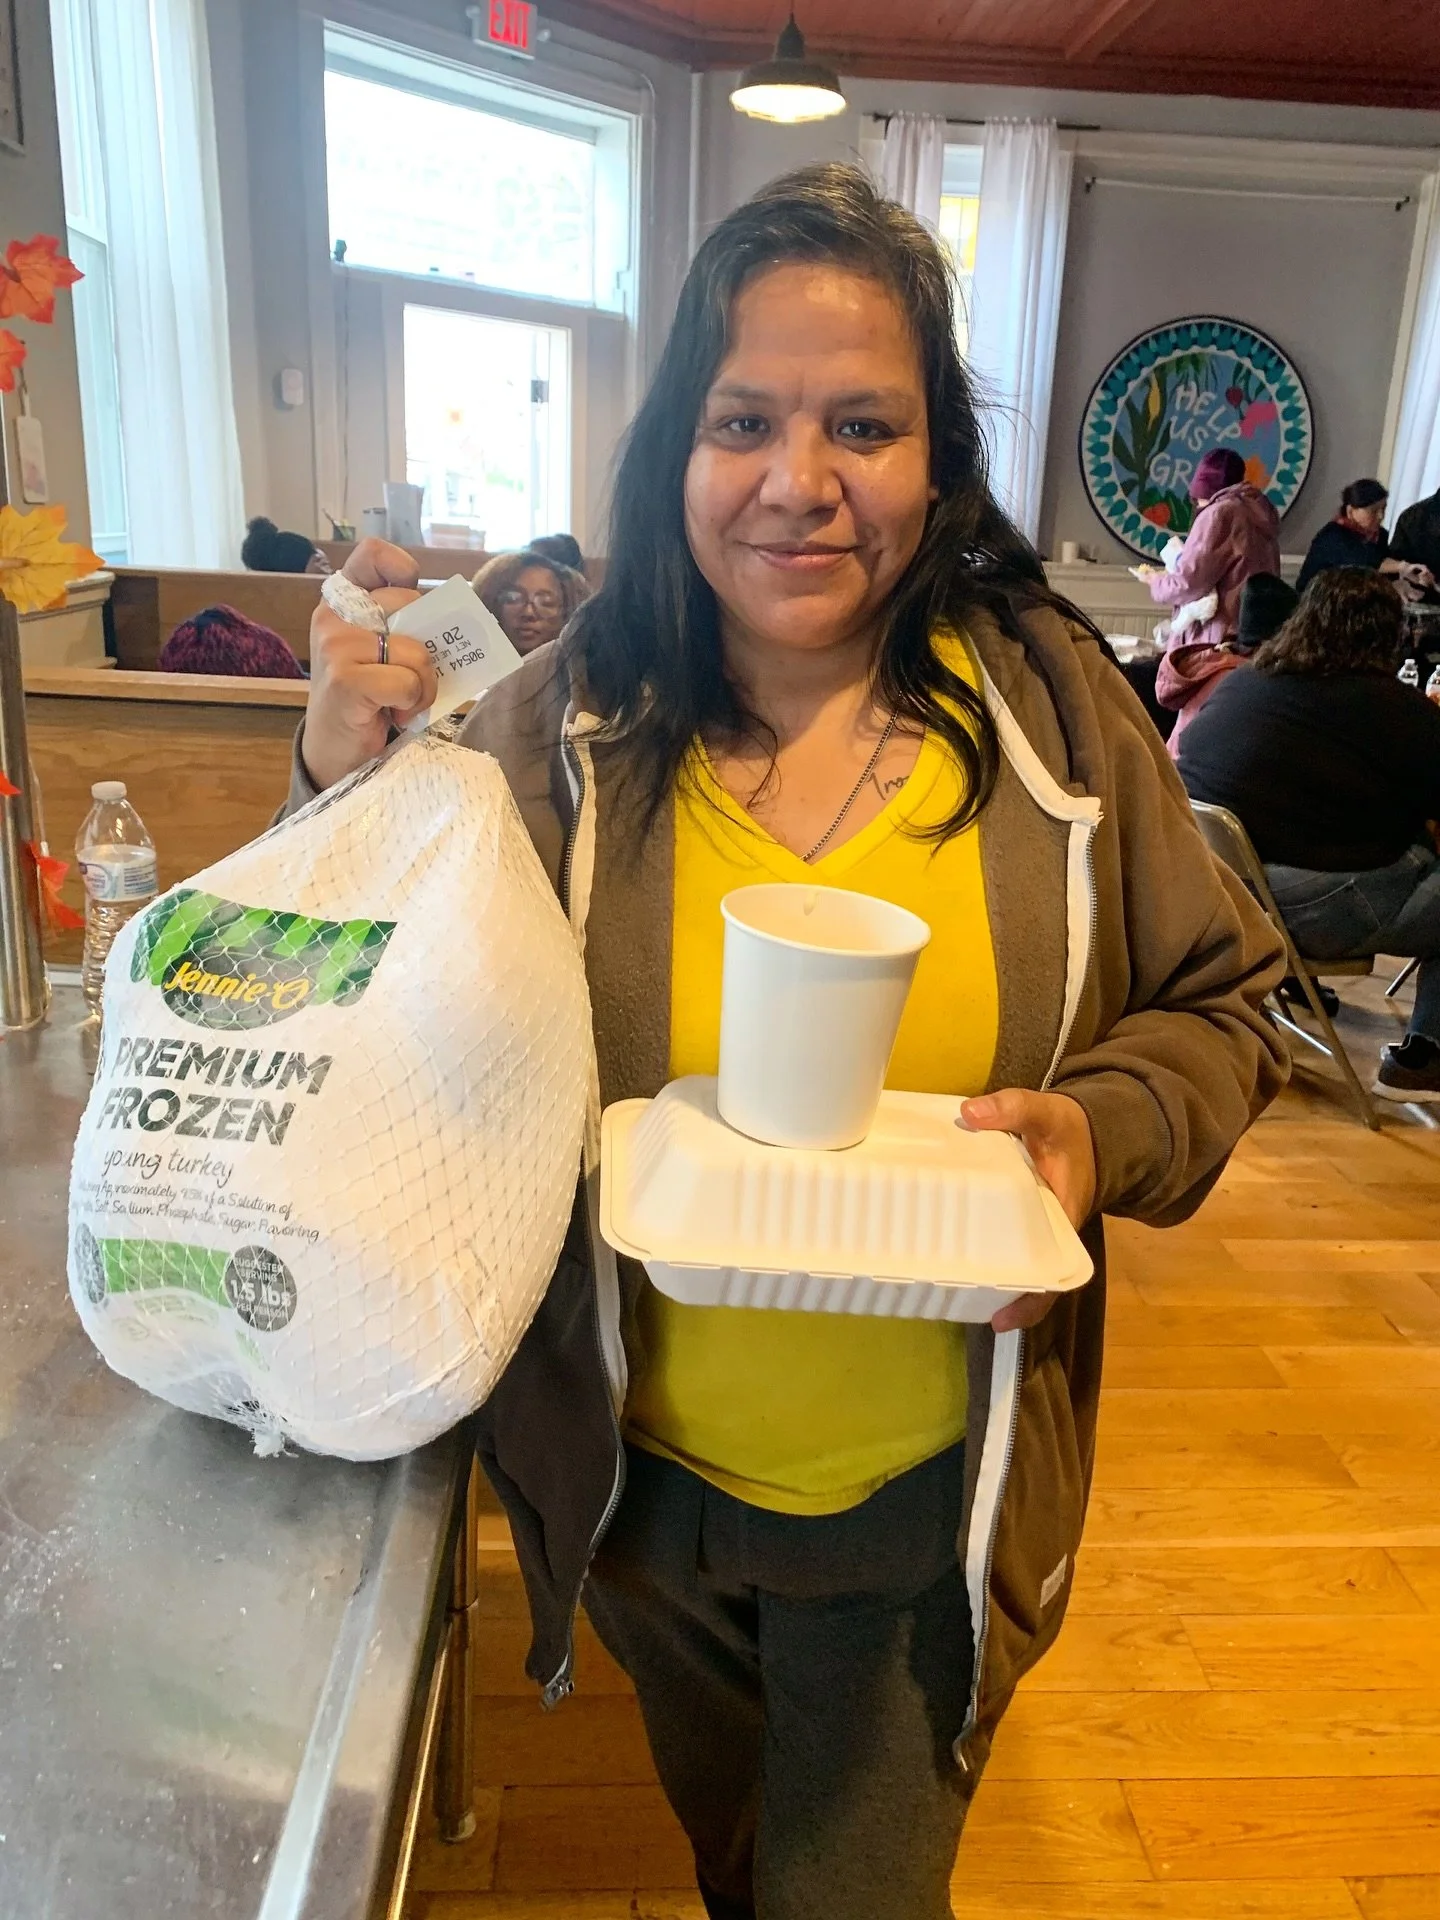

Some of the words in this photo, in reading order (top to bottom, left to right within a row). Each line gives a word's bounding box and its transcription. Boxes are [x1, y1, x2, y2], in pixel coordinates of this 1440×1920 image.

[489, 0, 531, 49] EXIT
[1174, 380, 1242, 442] HELP
[1169, 416, 1210, 452] US
[1149, 451, 1193, 489] GR
[449, 648, 485, 671] 90544
[455, 639, 472, 652] NET
[164, 961, 310, 1010] Jennie-O
[110, 1036, 333, 1096] PREMIUM
[96, 1086, 297, 1146] FROZEN
[101, 1149, 162, 1180] young
[168, 1148, 234, 1189] turkey
[279, 1202, 294, 1221] of
[230, 1279, 256, 1302] 1.5
